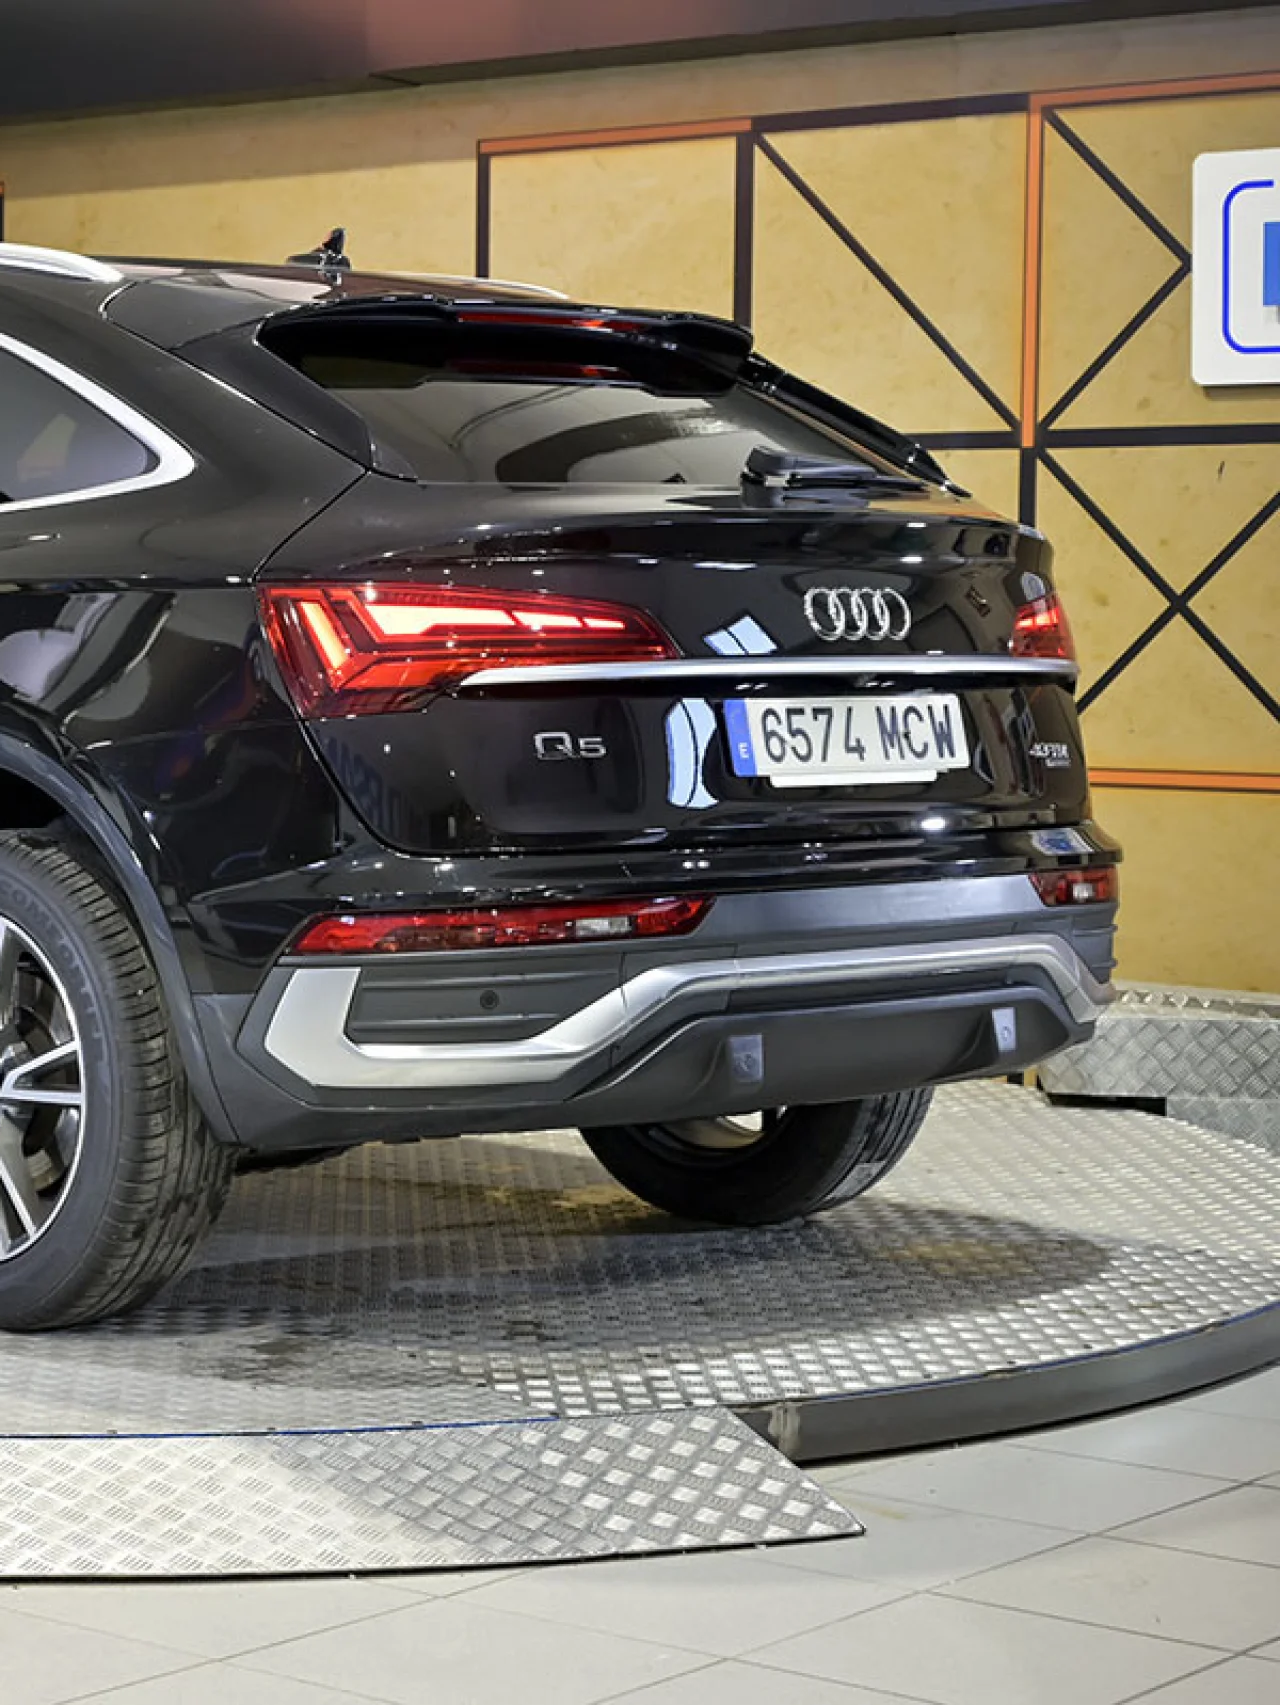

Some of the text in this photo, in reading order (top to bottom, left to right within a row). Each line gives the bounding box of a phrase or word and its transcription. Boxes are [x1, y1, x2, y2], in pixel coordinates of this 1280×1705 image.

[533, 731, 607, 760] Q5
[760, 703, 956, 763] 6574 MCW
[737, 742, 750, 758] E
